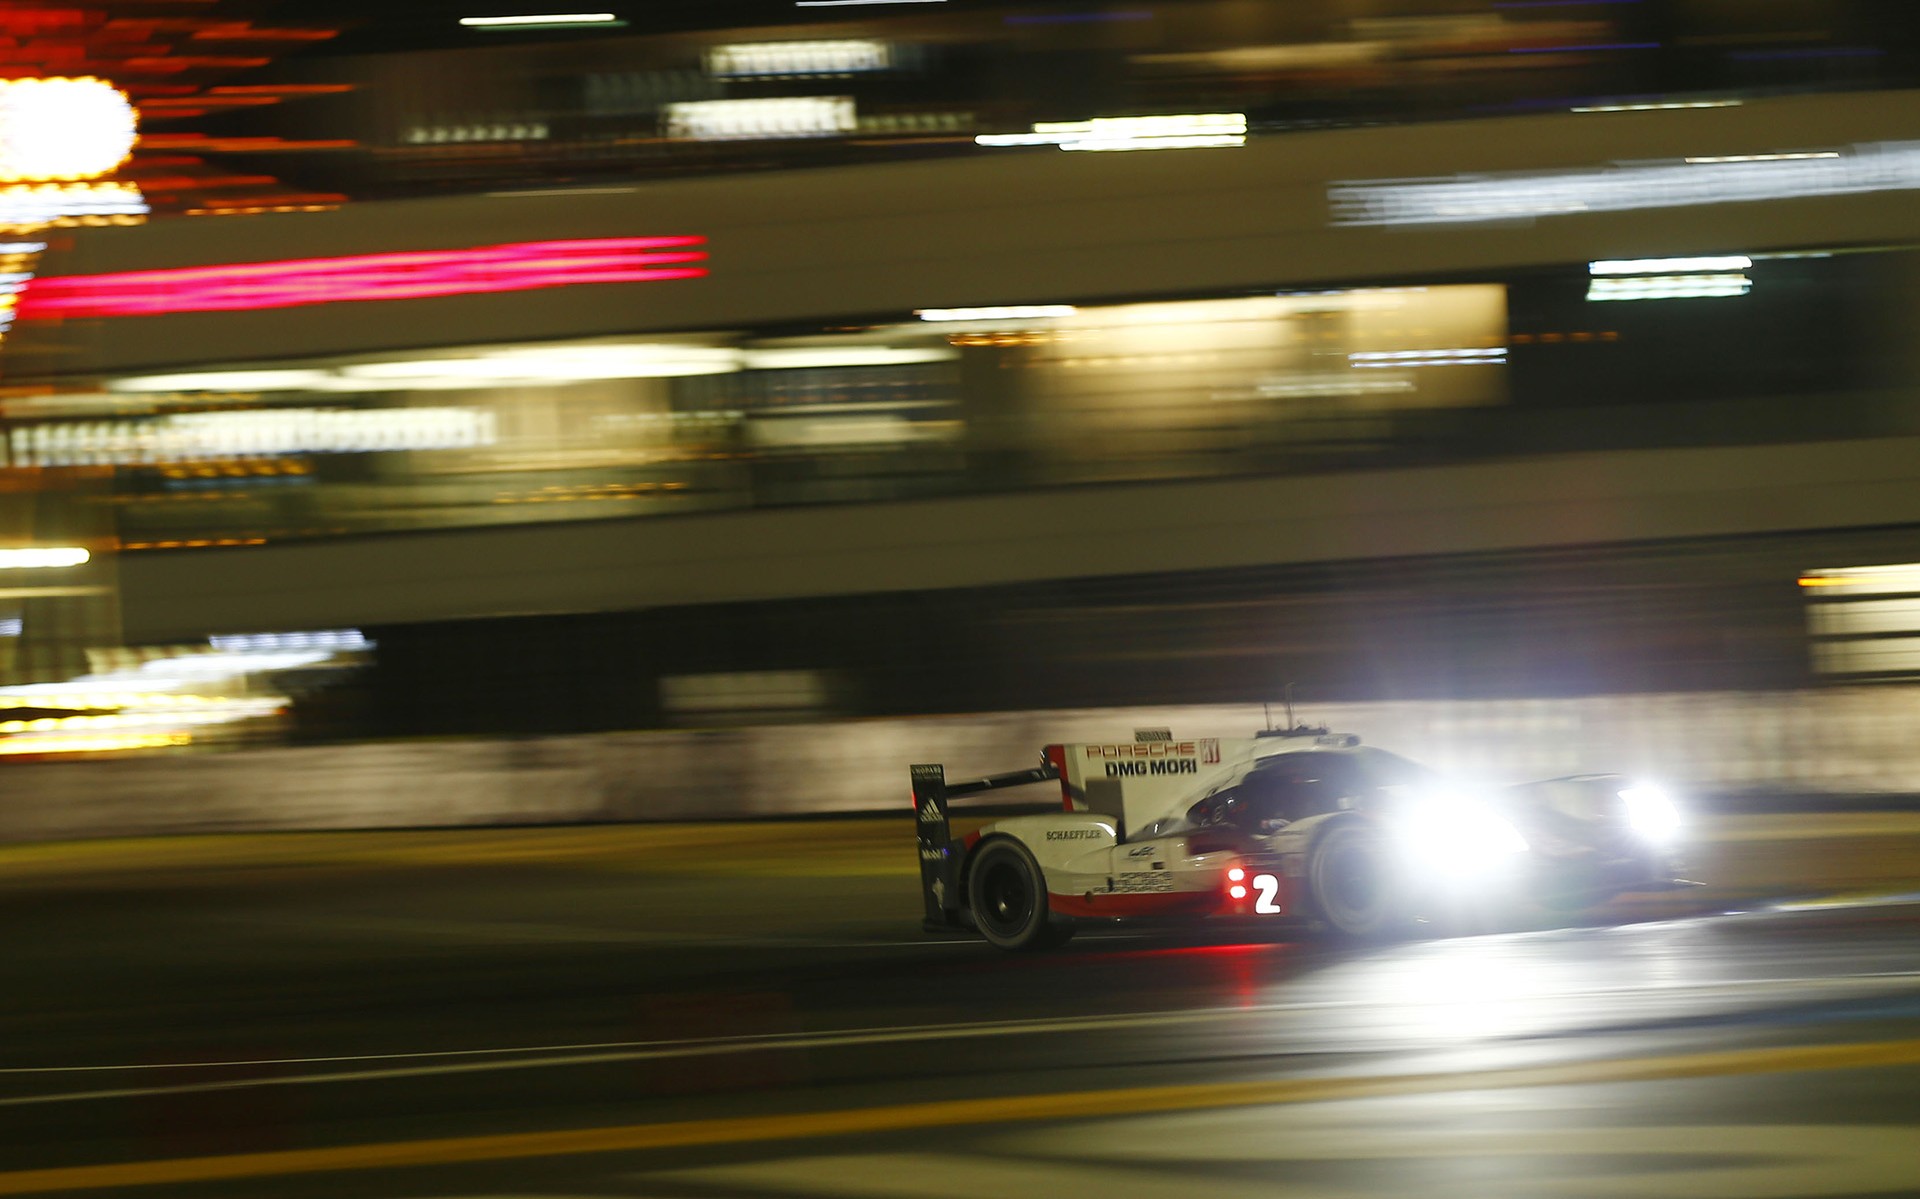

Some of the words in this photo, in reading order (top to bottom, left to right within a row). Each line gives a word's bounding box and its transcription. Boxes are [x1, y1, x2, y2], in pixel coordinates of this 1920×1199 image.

[1086, 742, 1195, 759] PORSCHE
[1105, 760, 1147, 777] DMG
[1150, 759, 1197, 774] MORI
[1046, 829, 1101, 840] SCHAEFFLER
[1253, 874, 1281, 914] 2
